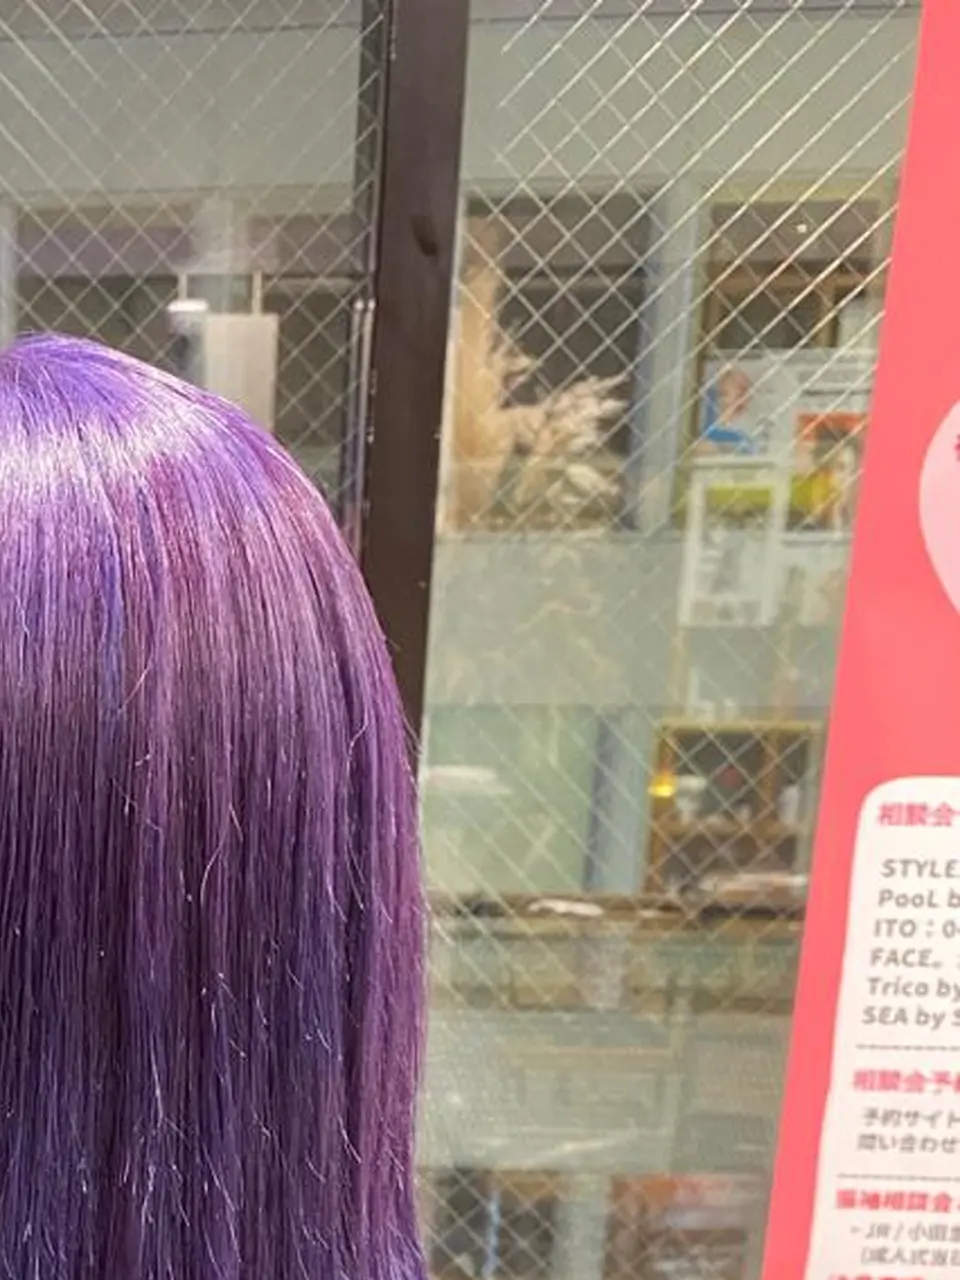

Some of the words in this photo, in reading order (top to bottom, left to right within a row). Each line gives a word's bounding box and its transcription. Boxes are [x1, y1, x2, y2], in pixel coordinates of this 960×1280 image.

[878, 803, 960, 827] 相談会
[874, 919, 917, 938] ITO
[867, 976, 929, 997] Trico
[862, 1005, 908, 1026] SEA
[916, 1008, 946, 1031] by
